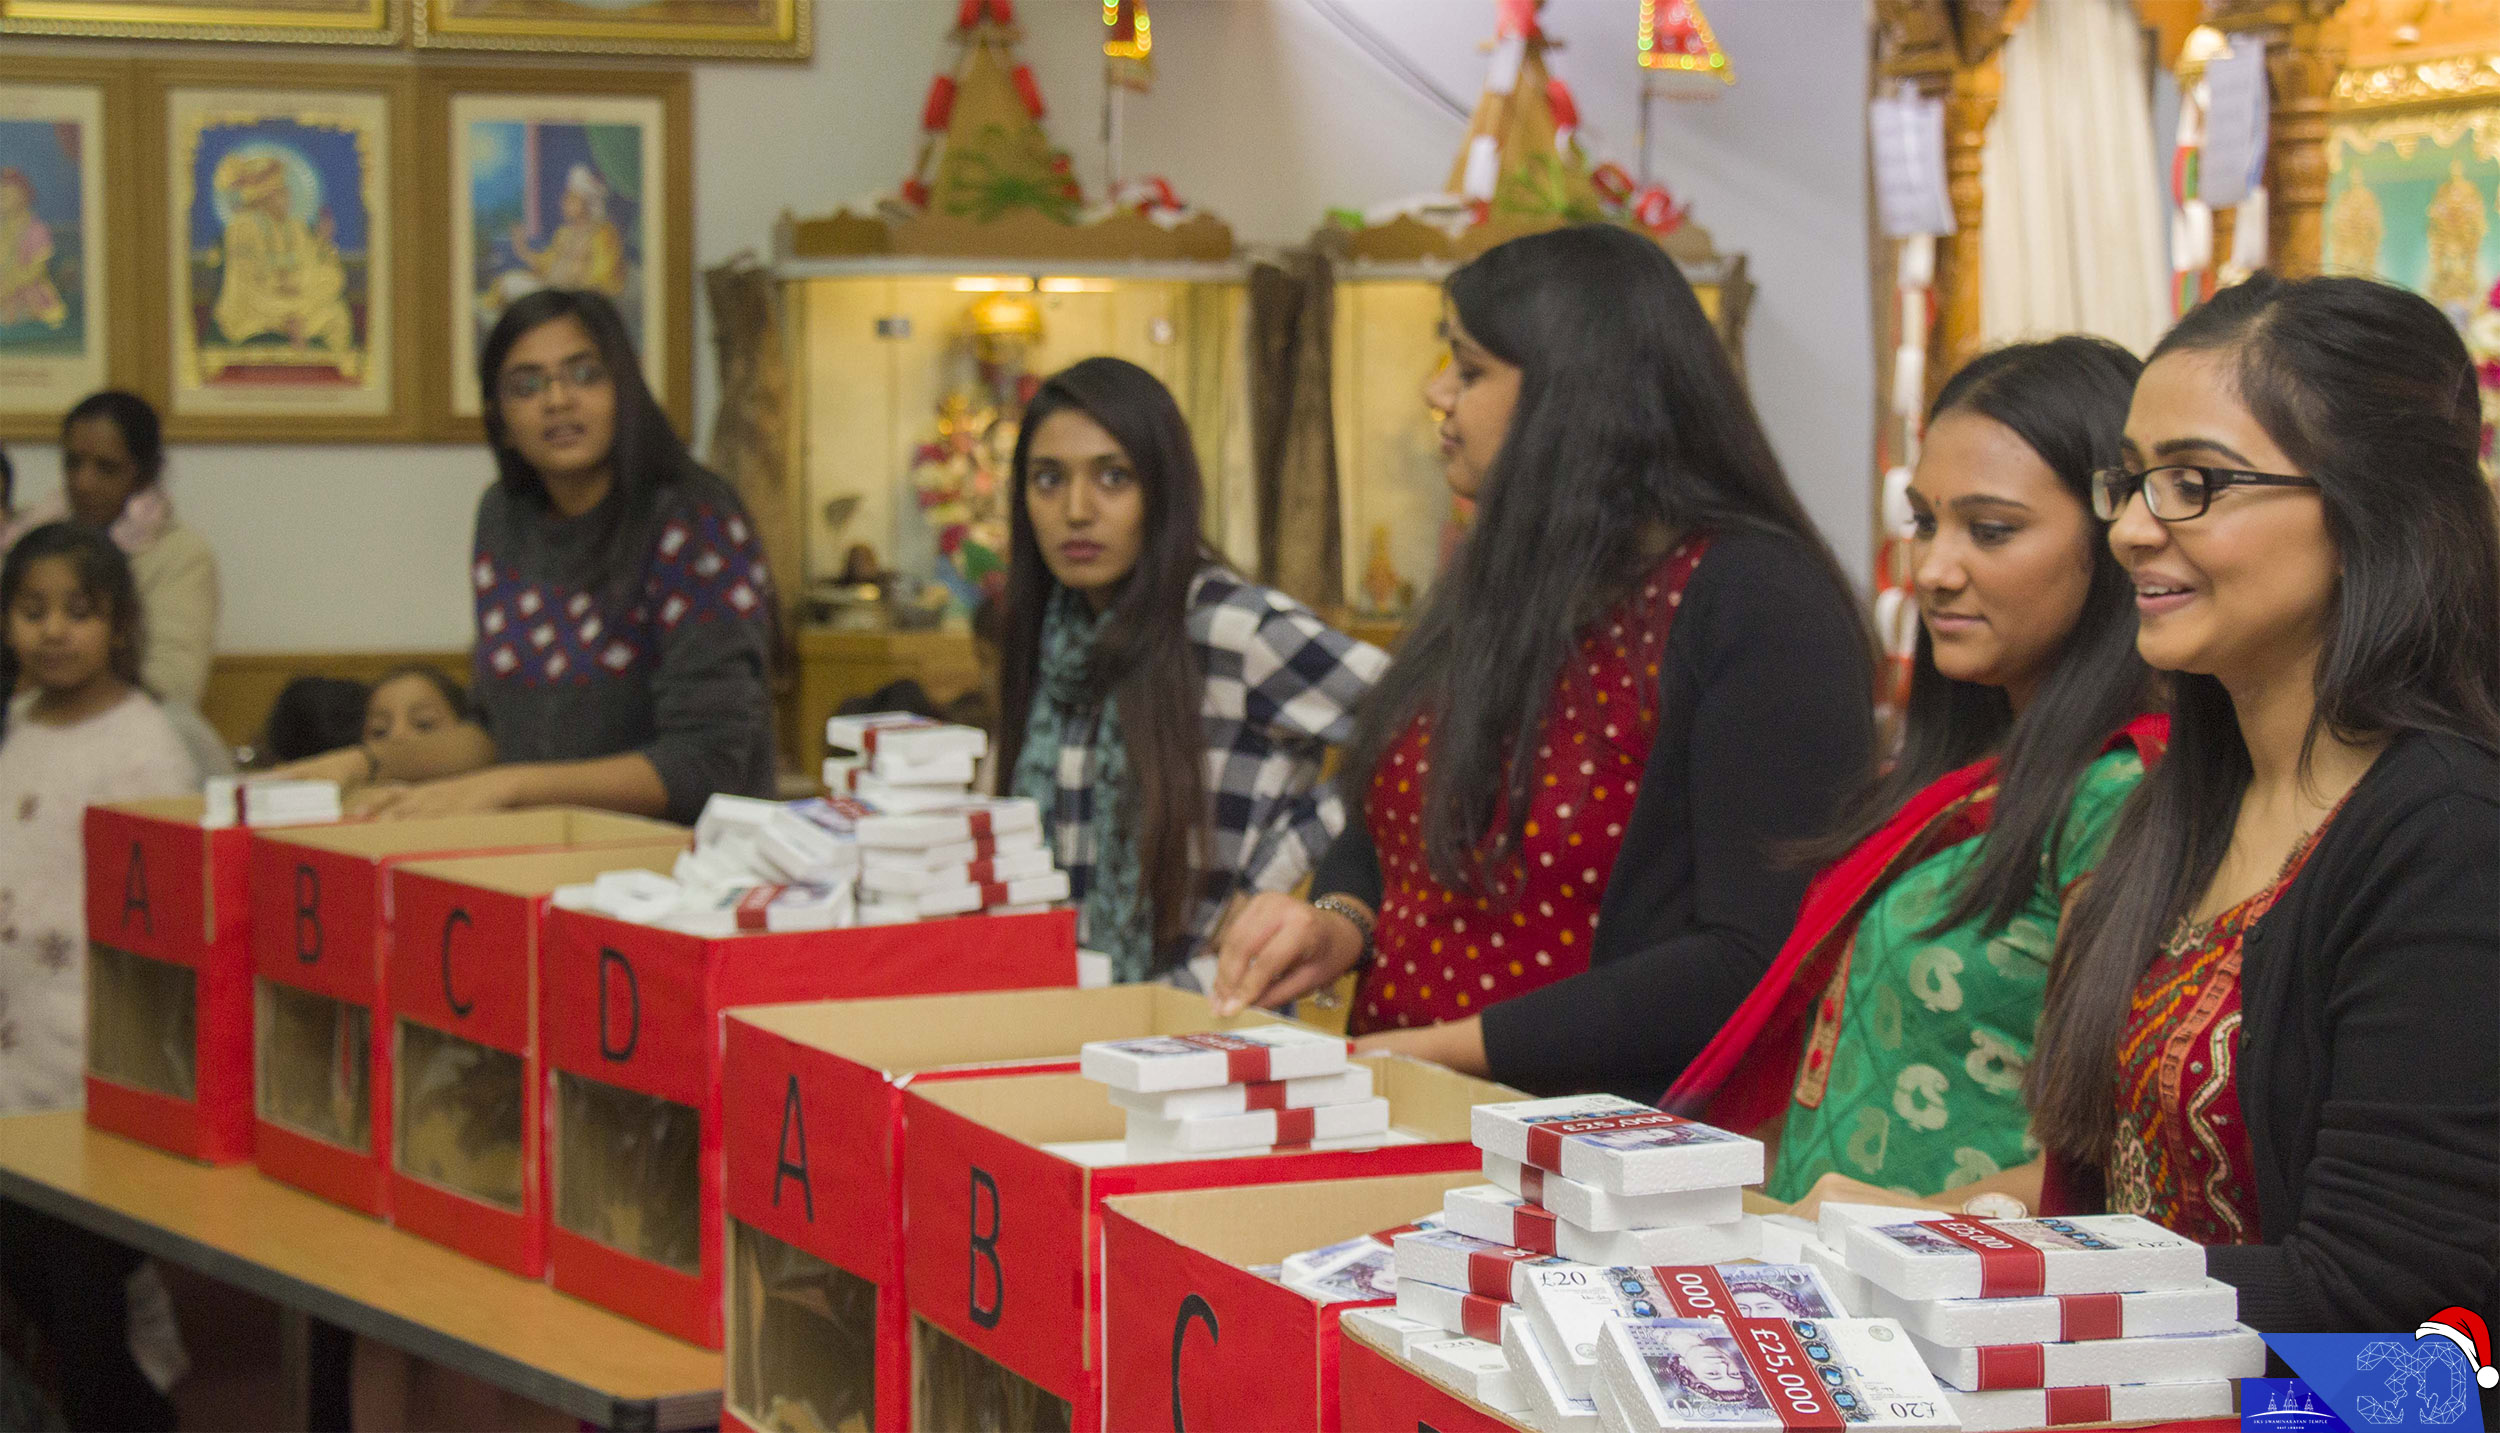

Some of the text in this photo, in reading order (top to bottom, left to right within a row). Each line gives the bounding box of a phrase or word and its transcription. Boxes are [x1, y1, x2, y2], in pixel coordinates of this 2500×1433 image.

[119, 839, 155, 937] A
[293, 861, 324, 966] B
[441, 907, 475, 1018] C
[599, 946, 641, 1064] D
[773, 1074, 814, 1223] A
[1562, 1115, 1674, 1132] £25,000
[969, 1166, 1004, 1330] B
[1541, 1271, 1587, 1287] £20
[1171, 1294, 1220, 1433] C
[1750, 1327, 1821, 1415] £25,000
[1890, 1402, 1937, 1418] £20
